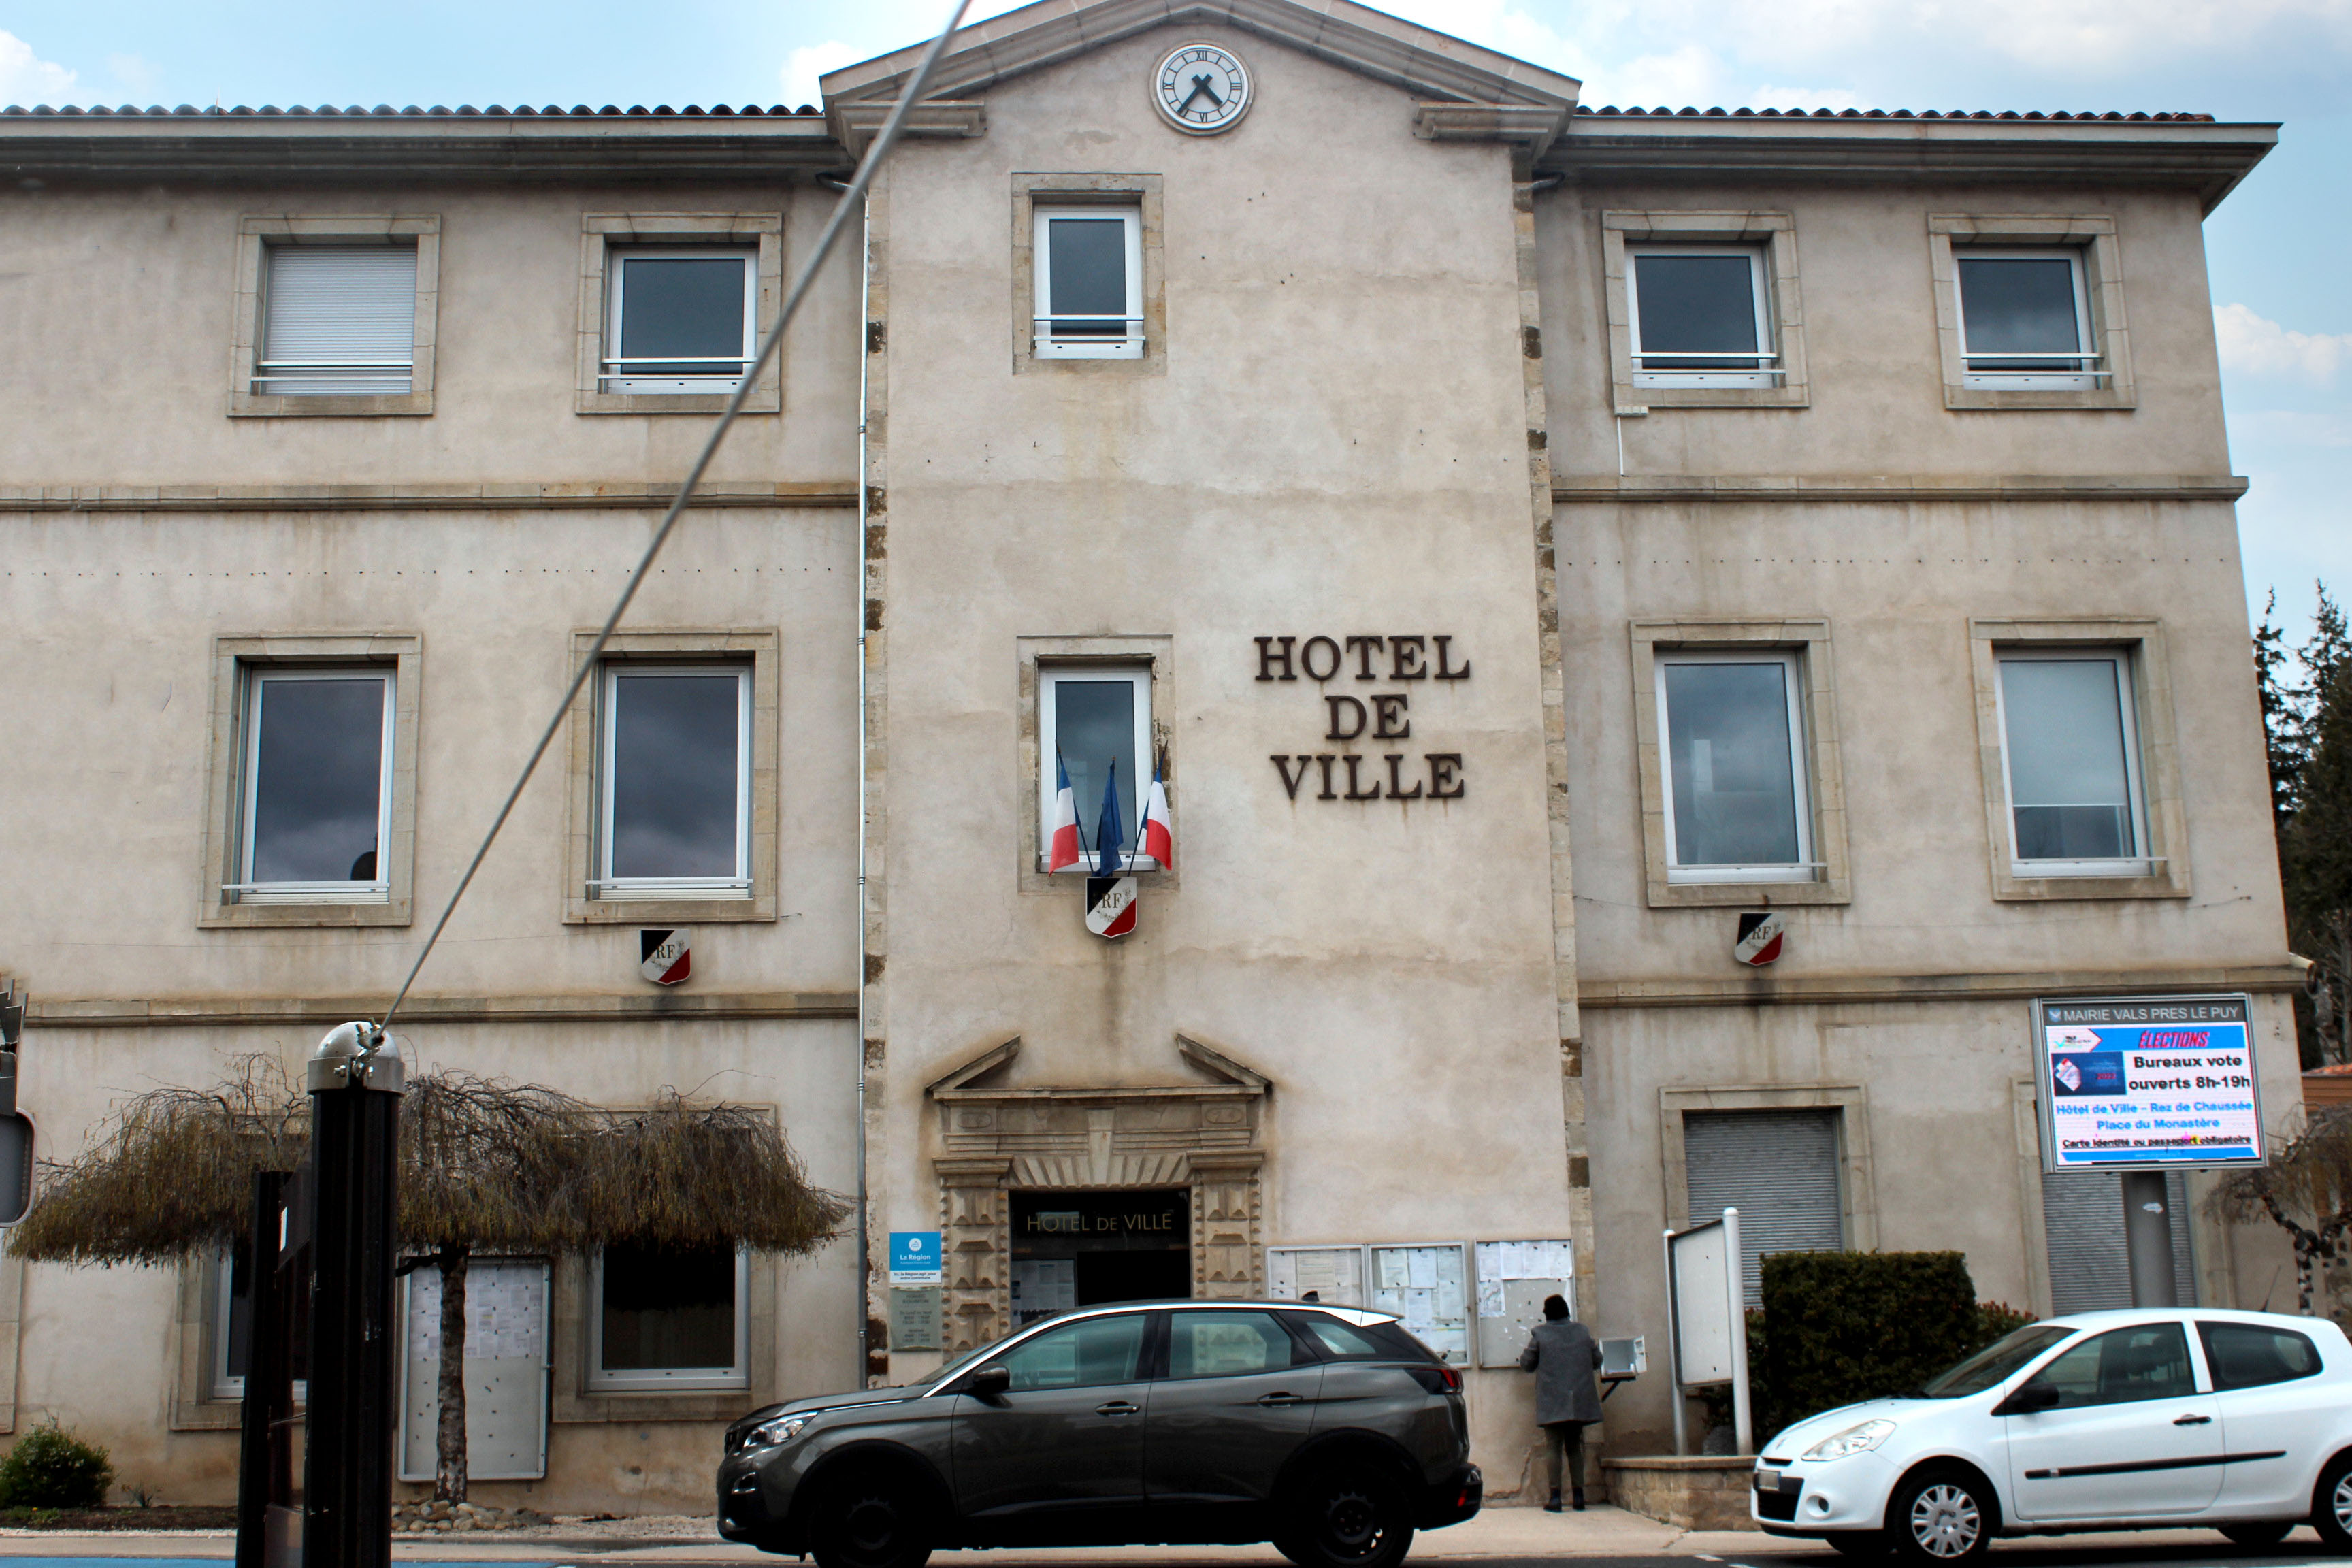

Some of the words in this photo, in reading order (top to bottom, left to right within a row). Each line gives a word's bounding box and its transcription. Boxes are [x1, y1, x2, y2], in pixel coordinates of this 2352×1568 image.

[1196, 50, 1207, 61] XII
[1254, 635, 1471, 681] HOTEL
[1324, 693, 1411, 740] DE
[1269, 753, 1465, 800] VILLE
[1100, 892, 1122, 909] RF
[1752, 926, 1771, 940] RF
[656, 944, 675, 959] RF
[2063, 1009, 2110, 1021] MAIRIE
[2112, 1007, 2148, 1020] VALS
[2151, 1007, 2188, 1019] PRES
[2191, 1007, 2208, 1019] LE
[2212, 1006, 2239, 1018] PUY
[2138, 1029, 2211, 1049] ÉLECTIONS
[2133, 1056, 2203, 1068] Bureaux
[2206, 1055, 2242, 1067] vote
[2129, 1077, 2191, 1090] ouverts
[2195, 1075, 2251, 1088] 8h-19h
[2056, 1104, 2089, 1115] Hôtel
[2092, 1103, 2108, 1114] de
[2110, 1102, 2138, 1114] Ville
[2150, 1102, 2172, 1112] Rez
[2176, 1102, 2191, 1112] de
[2193, 1101, 2253, 1111] Chaussée
[2097, 1120, 2132, 1130] Place
[2135, 1120, 2151, 1129] du
[2153, 1117, 2220, 1129] Monastère
[2063, 1139, 2091, 1149] Carte
[1027, 1215, 1091, 1232] HOTEL
[1096, 1217, 1118, 1231] DE
[1124, 1213, 1172, 1231] VILLE
